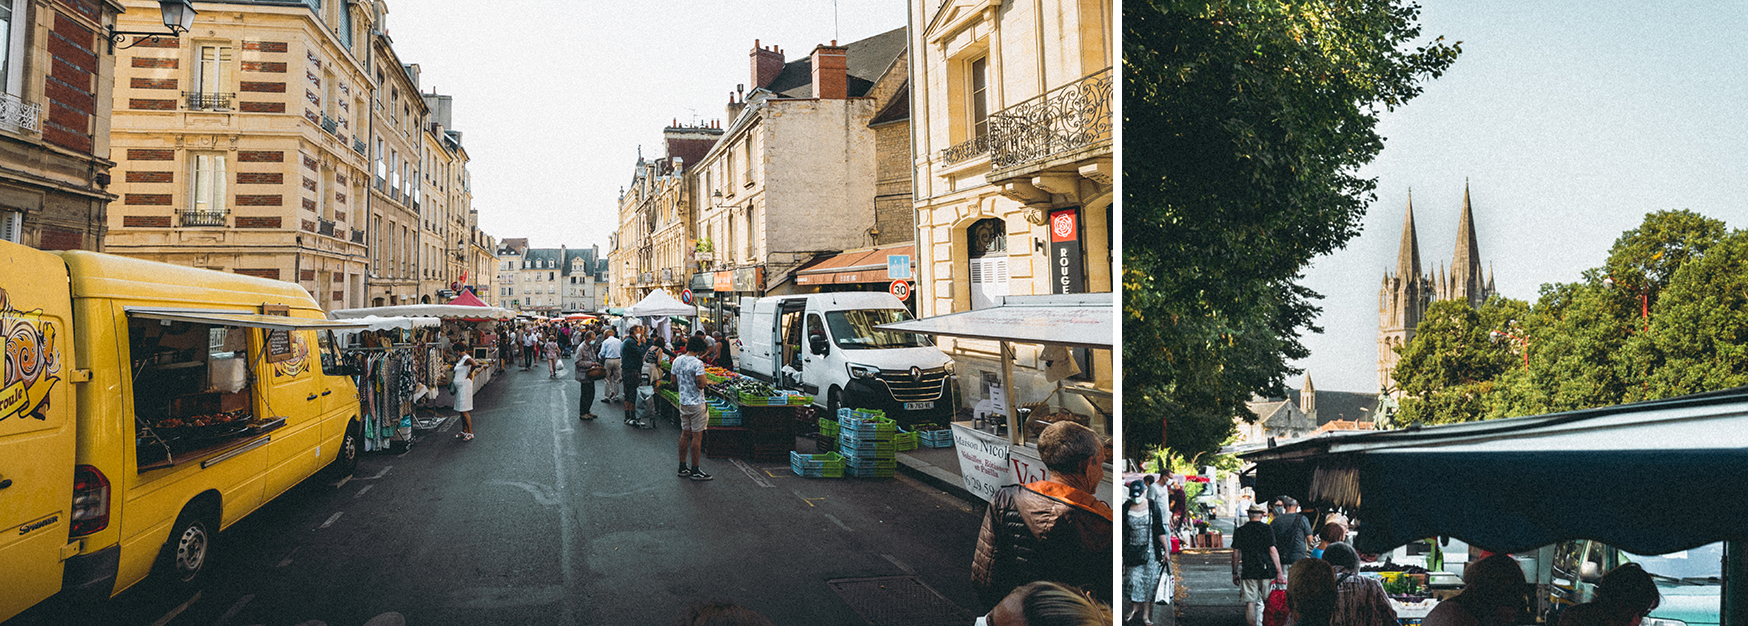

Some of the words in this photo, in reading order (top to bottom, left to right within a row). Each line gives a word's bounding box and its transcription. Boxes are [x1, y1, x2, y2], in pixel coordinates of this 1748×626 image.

[1059, 248, 1071, 294] ROUGE
[894, 285, 907, 295] 30
[954, 435, 979, 450] Maison
